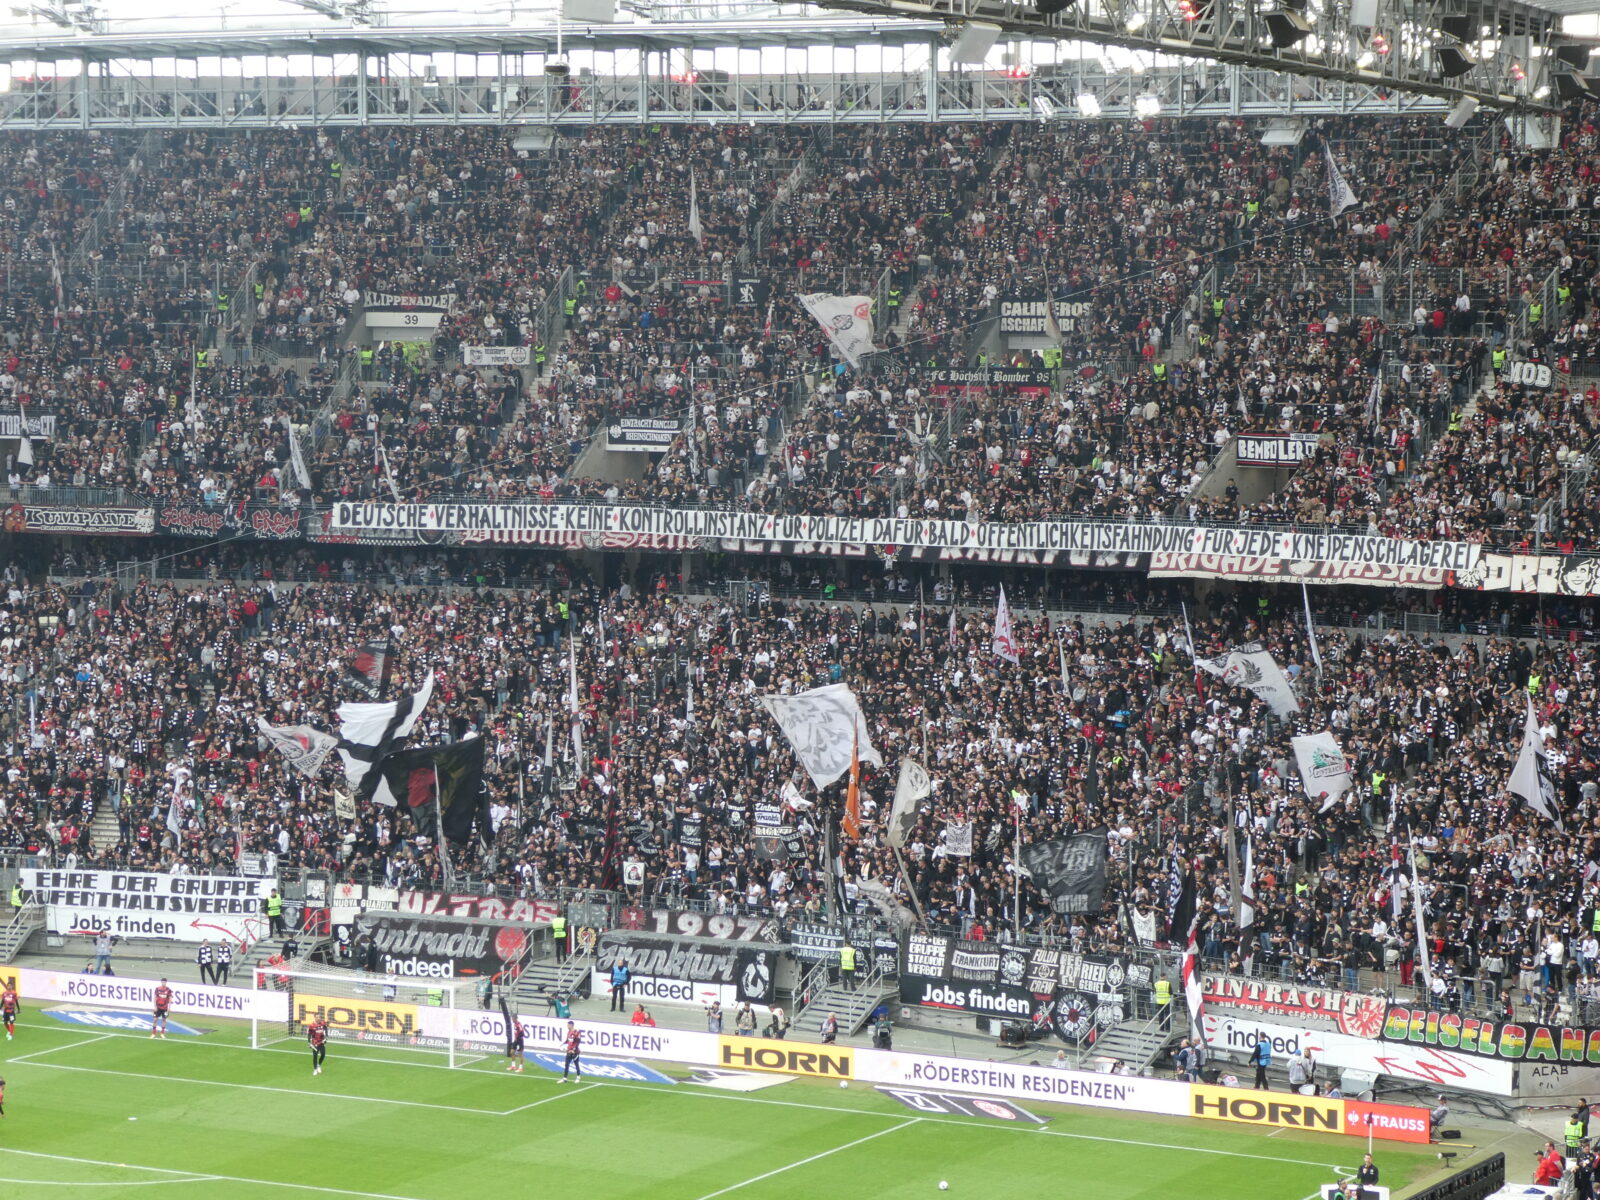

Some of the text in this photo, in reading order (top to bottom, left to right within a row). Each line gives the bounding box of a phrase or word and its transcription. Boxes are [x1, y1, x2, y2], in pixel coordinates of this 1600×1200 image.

[404, 315, 419, 325] 39
[25, 508, 136, 527] KUMPANE
[340, 503, 428, 528] DEUTSCHE
[566, 506, 613, 530] KEINE
[619, 507, 767, 539] KONTROLLINSTANZ
[773, 516, 803, 539] FÜR
[808, 517, 868, 543] POLIZEI,
[872, 518, 923, 544] DAFÜR
[928, 521, 970, 546] BALD
[1202, 529, 1236, 553] FÜR
[1236, 530, 1282, 557] JEDE
[36, 871, 262, 896] EHRE DER GRUPPE
[23, 889, 264, 914] AUFENTHALTSVERBO
[361, 899, 393, 910] GUARDIA
[399, 890, 560, 923] ULTRAS
[70, 913, 176, 935] Jobs finden
[652, 909, 766, 942] 1997
[796, 923, 841, 936] ULTRAS
[354, 917, 490, 959] Eintracht
[799, 936, 837, 947] NEVER
[908, 953, 944, 966] STADION
[909, 943, 946, 957] GRUPPE
[1033, 949, 1058, 963] FULDA
[385, 954, 454, 979] indeed
[596, 941, 738, 981] Frankfurt
[907, 963, 943, 977] VERBOT
[955, 954, 999, 969] FRANKFURT
[1082, 962, 1107, 982] RIED
[1030, 980, 1055, 995] CREW
[1079, 979, 1105, 993] GEBIET
[1201, 977, 1362, 1015] EINTRACHT
[168, 990, 250, 1011] ESIDENZEN“
[922, 984, 1030, 1014] Jobs finden
[299, 1003, 413, 1033] HORN
[1240, 1003, 1263, 1014] ewig
[1268, 1005, 1284, 1015] dir
[1288, 1009, 1331, 1021] ergeben
[462, 1016, 670, 1052] „RÖDSTEIN ESIDENZEN“
[723, 1045, 849, 1076] HORN
[1532, 1064, 1569, 1077] ACAB
[1195, 1094, 1338, 1130] HORN
